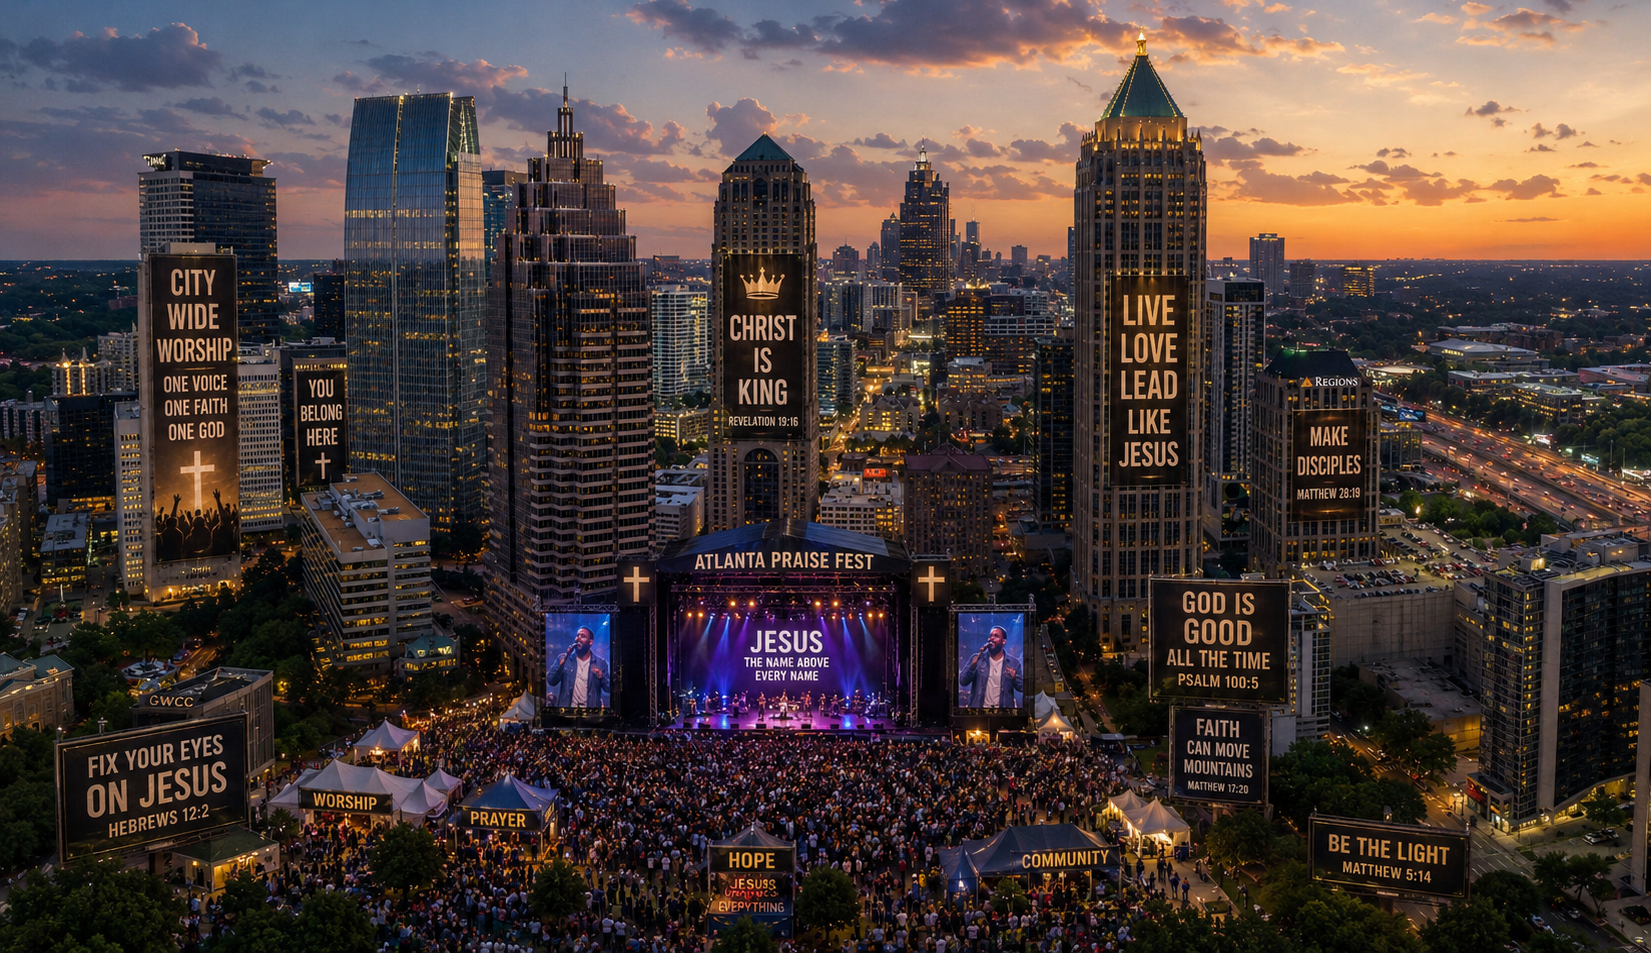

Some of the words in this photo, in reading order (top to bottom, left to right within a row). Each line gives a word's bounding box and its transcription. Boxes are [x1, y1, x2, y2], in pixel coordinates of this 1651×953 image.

[171, 269, 215, 296] CITY
[167, 304, 219, 329] WIDE
[1124, 295, 1175, 325] LIVE
[730, 315, 796, 340] CHRIST
[157, 338, 232, 362] WORSHIP
[1121, 333, 1177, 363] LOVE
[755, 348, 771, 373] IS
[164, 376, 188, 392] ONE
[193, 375, 227, 391] VOICE
[309, 379, 333, 397] YOU
[739, 379, 787, 405] KING
[1121, 370, 1177, 399] LEAD
[165, 400, 189, 416] ONE
[195, 398, 227, 414] FAITH
[301, 404, 342, 421] BELONG
[169, 423, 194, 440] ONE
[200, 422, 224, 438] GOD
[729, 416, 775, 426] REVELATION
[778, 417, 798, 426] 19:16
[1129, 409, 1170, 434] LIKE
[307, 428, 338, 446] HERE
[1311, 426, 1348, 446] MAKE
[1119, 441, 1178, 467] JESUS
[1298, 455, 1360, 475] DISCIPLES
[1297, 488, 1337, 499] MATTHEW
[1339, 487, 1360, 498] 28:19
[695, 552, 765, 569] ATLANTA
[772, 552, 829, 568] PRAISE
[836, 553, 874, 569] FEST
[1182, 591, 1227, 615] GOD
[1235, 592, 1255, 616] IS
[1185, 617, 1253, 646] GOOD
[751, 631, 822, 653] JESUS
[744, 657, 762, 667] THE
[766, 657, 793, 667] NAME
[797, 657, 829, 667] ABOVE
[1167, 649, 1194, 666] ALL
[1199, 650, 1227, 668] THE
[1232, 651, 1270, 669] TIME
[756, 671, 786, 681] EVERY
[791, 671, 818, 681] NAME
[1179, 673, 1220, 687] PSALM
[1225, 676, 1258, 689] 100:5
[150, 695, 193, 707] GWCC
[1197, 719, 1239, 738] FAITH
[89, 753, 118, 778] FIX
[125, 744, 174, 770] YOUR
[181, 735, 223, 760] EYES
[1188, 740, 1210, 755] CAN
[1216, 742, 1249, 758] MOVE
[1184, 759, 1252, 778] MOUNTAINS
[87, 778, 128, 818] ON
[138, 761, 227, 808] JESUS
[1187, 781, 1225, 794] MATTHEW
[1228, 784, 1248, 794] 17:20
[314, 793, 377, 810] WORSHIP
[109, 810, 178, 838] HEBREWS
[182, 804, 210, 823] 12:2
[470, 810, 526, 828] PRAYER
[1329, 834, 1350, 853] BE
[1357, 837, 1391, 858] THE
[1398, 842, 1449, 865] LIGHT
[729, 852, 775, 868] HOPE
[1022, 852, 1110, 869] COMMUNITY
[1343, 861, 1401, 879] MATTHEW
[1406, 869, 1431, 883] 5:14
